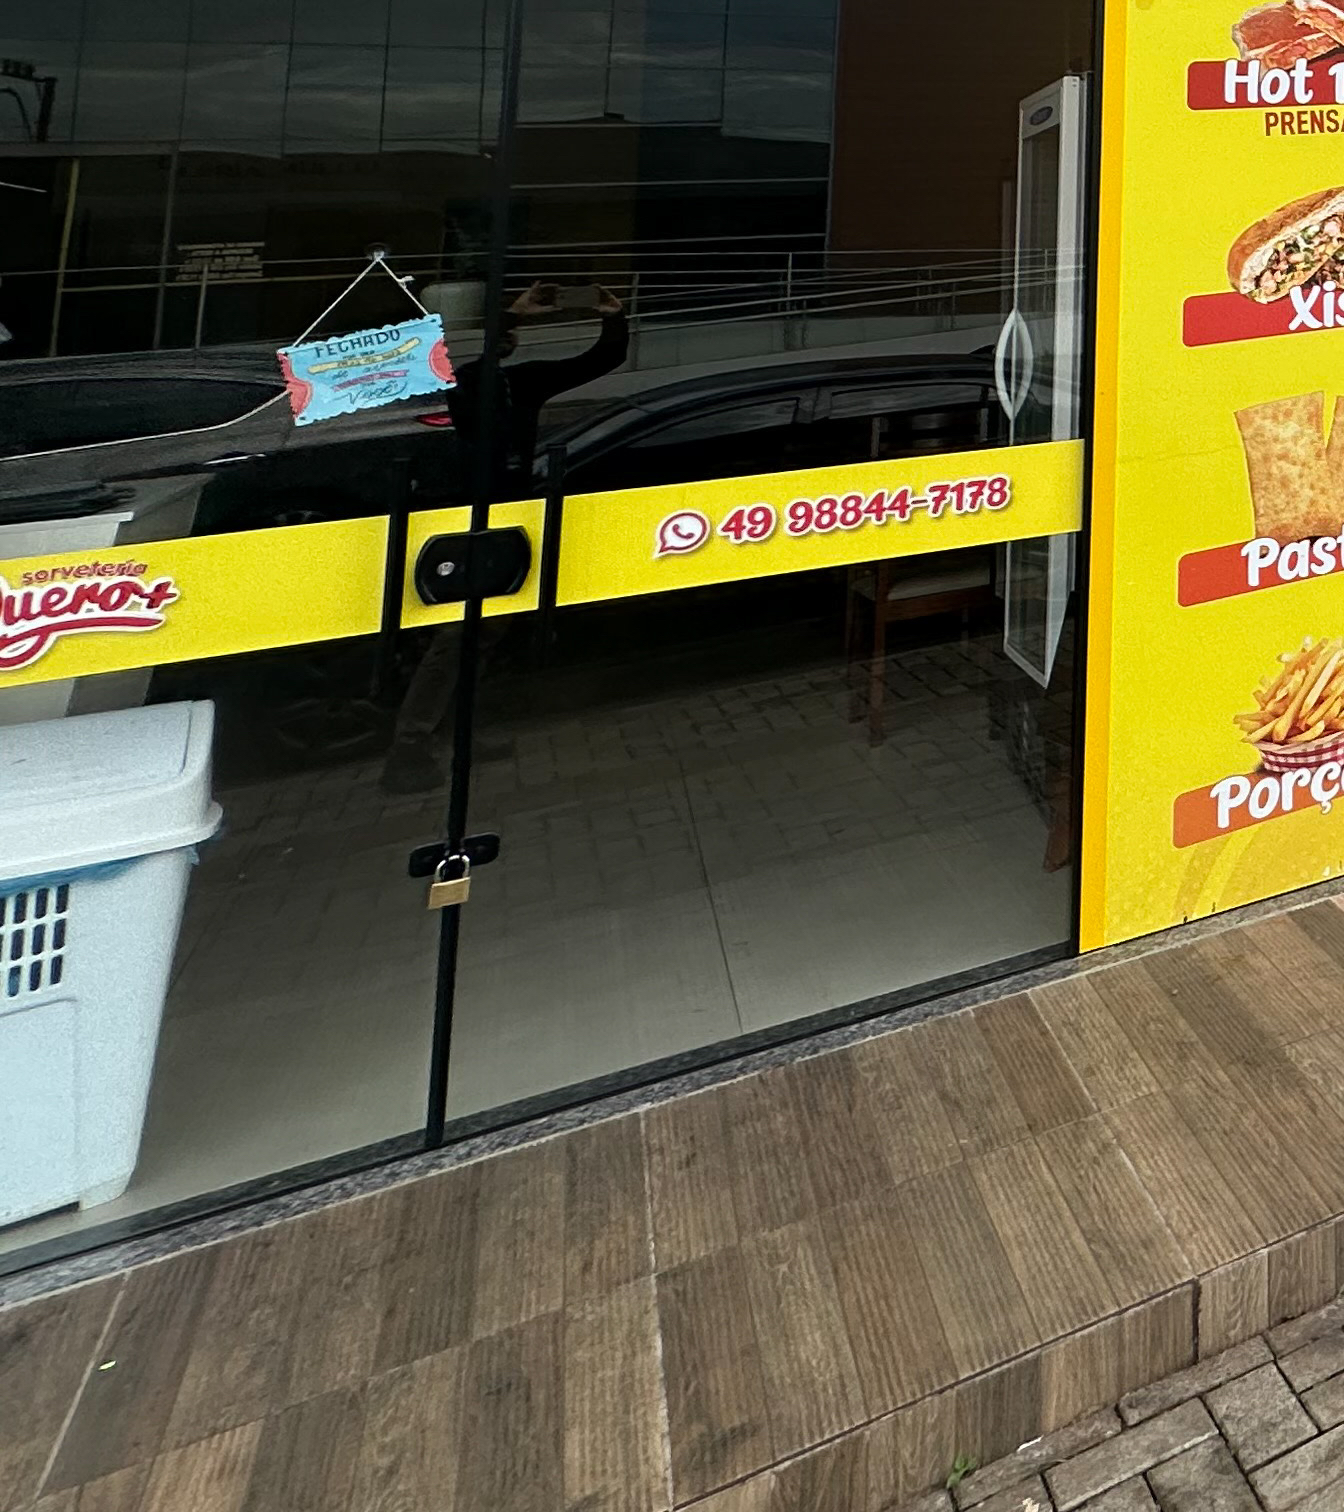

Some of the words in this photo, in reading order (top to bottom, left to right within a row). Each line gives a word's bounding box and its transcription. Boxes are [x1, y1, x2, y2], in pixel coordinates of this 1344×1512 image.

[1224, 57, 1313, 105] Hot
[314, 329, 400, 358] FECHADO
[720, 506, 773, 541] 49
[787, 476, 1009, 535] 98844-7178
[22, 559, 148, 585] sorveteria
[0, 572, 178, 669] uero+
